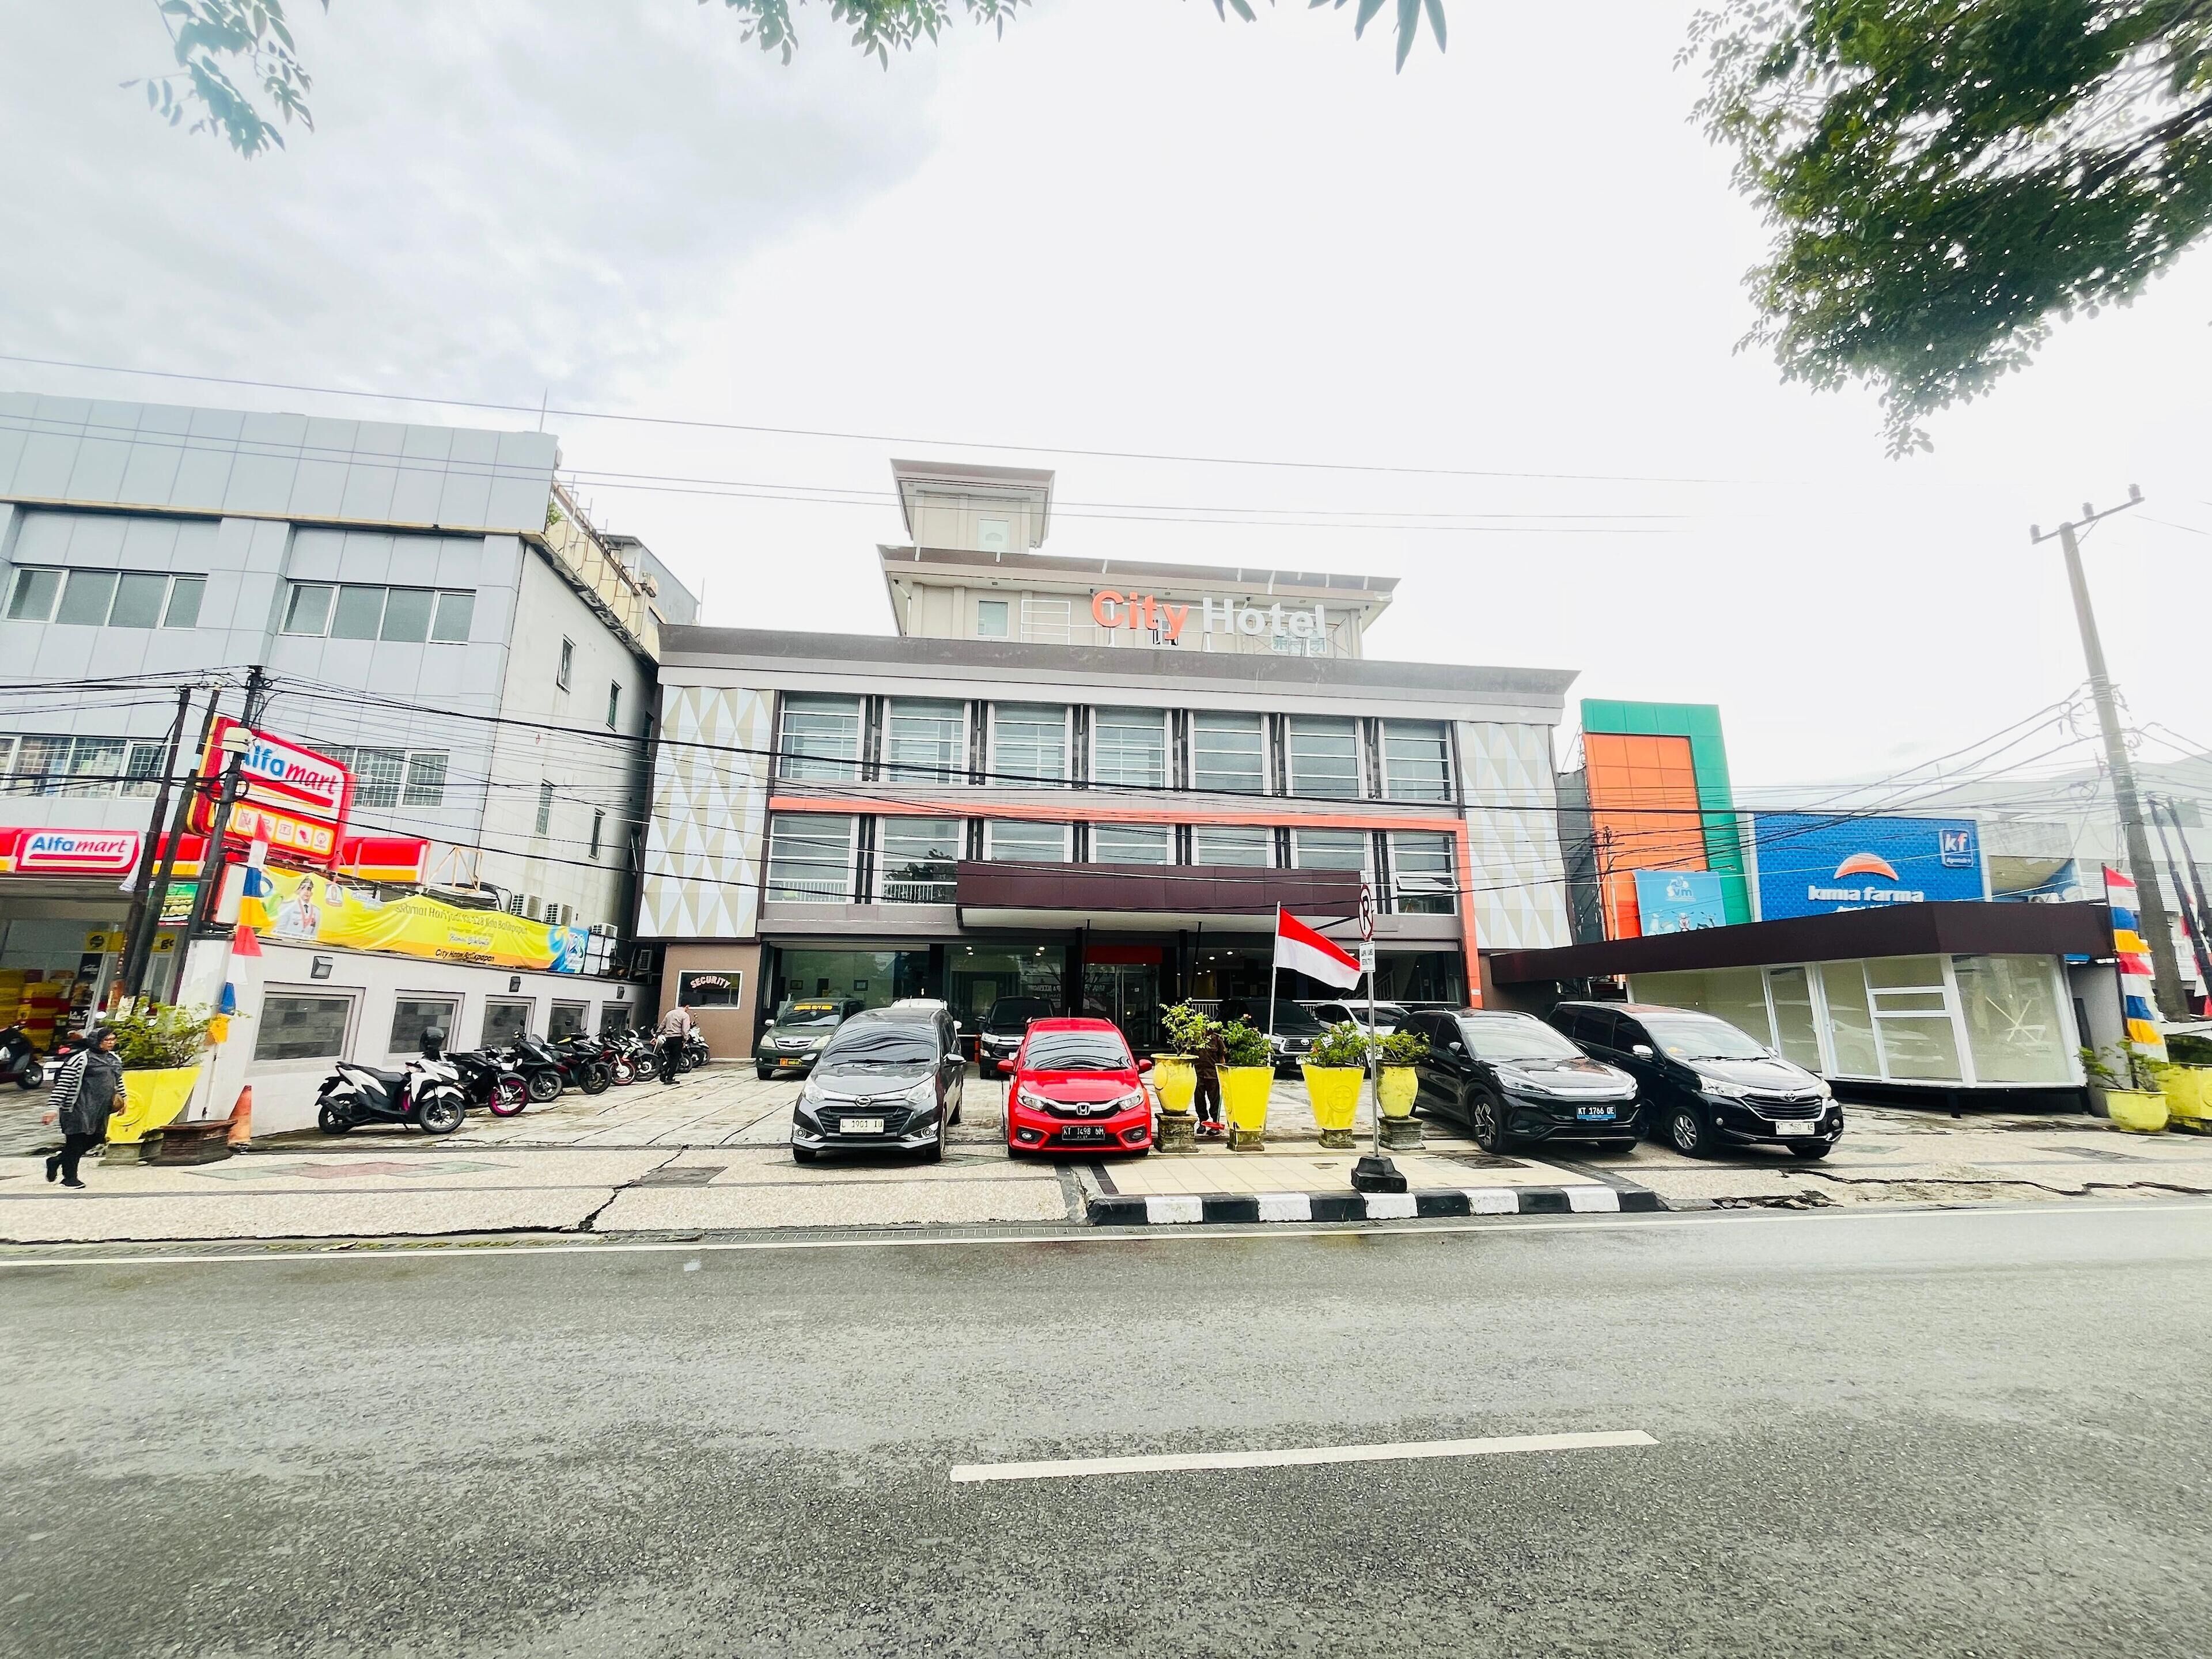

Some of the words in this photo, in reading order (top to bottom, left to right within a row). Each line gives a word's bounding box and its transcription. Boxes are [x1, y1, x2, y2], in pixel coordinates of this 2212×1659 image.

[1092, 590, 1190, 640] City
[1203, 597, 1325, 639] Hotel
[31, 836, 128, 853] Alfamart
[1944, 833, 1968, 851] kf
[1808, 885, 1861, 901] kimia
[1863, 886, 1925, 903] farma
[435, 949, 449, 959] City
[690, 975, 732, 988] SECURITY
